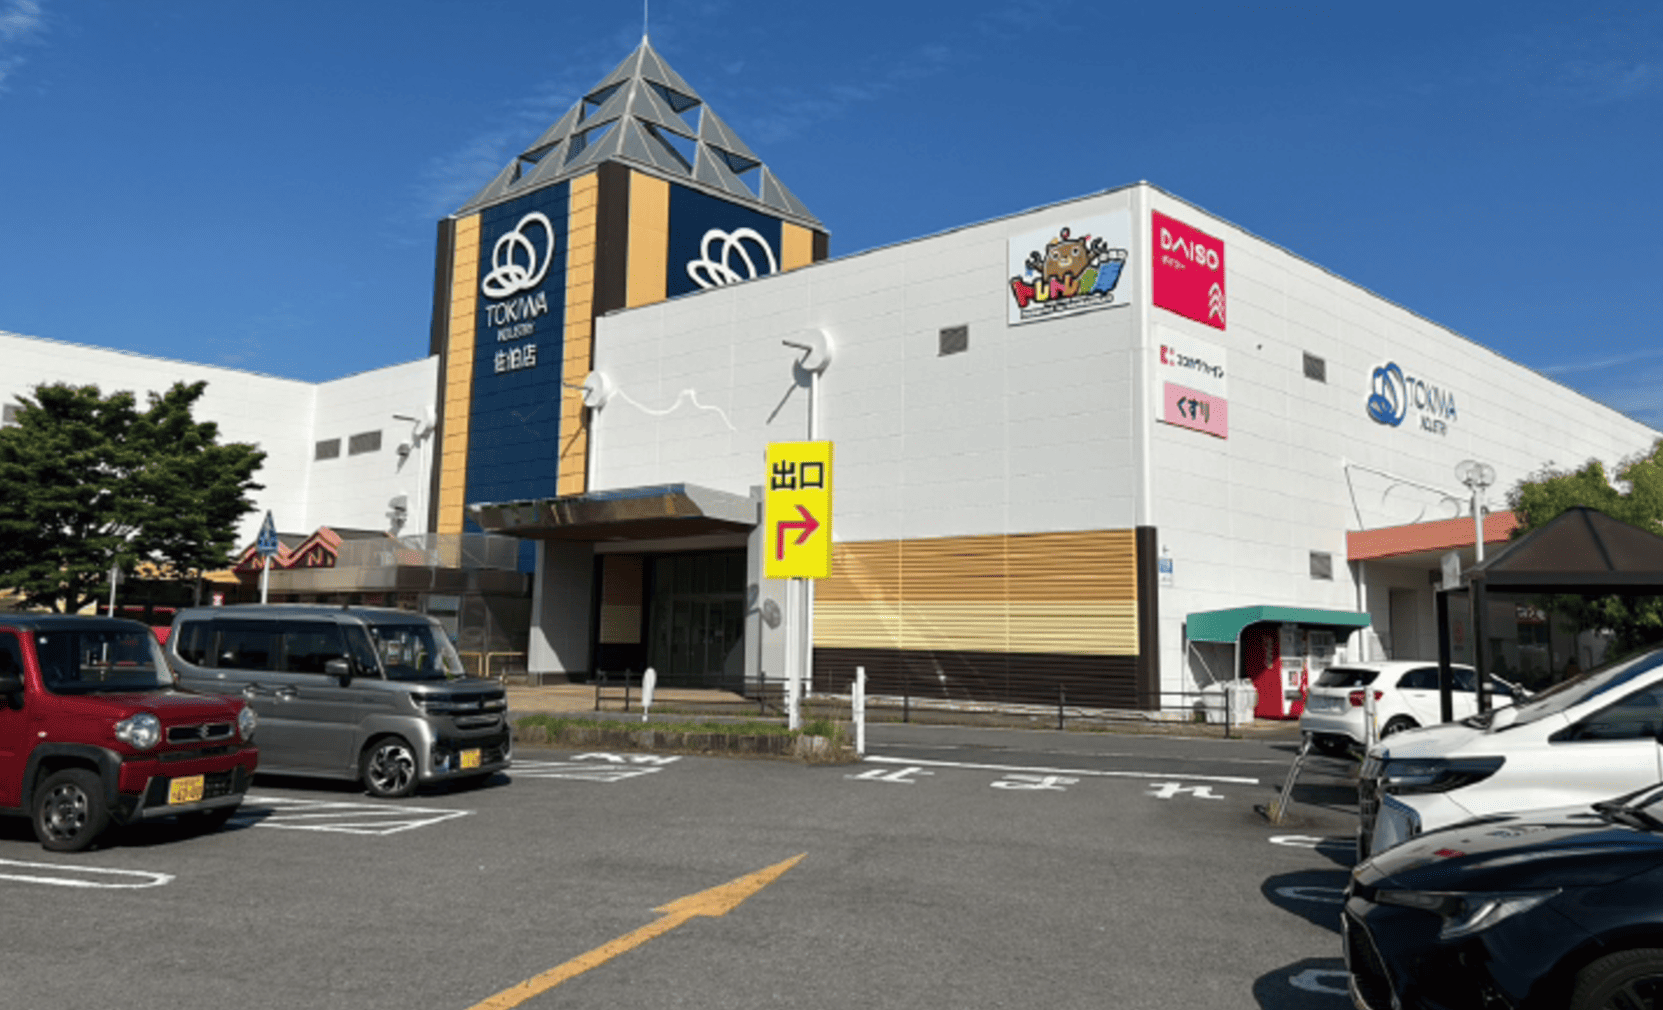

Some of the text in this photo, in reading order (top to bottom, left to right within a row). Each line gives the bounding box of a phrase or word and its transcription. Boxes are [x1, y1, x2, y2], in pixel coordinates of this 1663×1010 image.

[1160, 227, 1220, 271] DAISO
[485, 290, 549, 328] TOKIWA
[1176, 396, 1210, 424] くすり
[1405, 376, 1458, 422] TOKIWA
[770, 459, 825, 491] 出口
